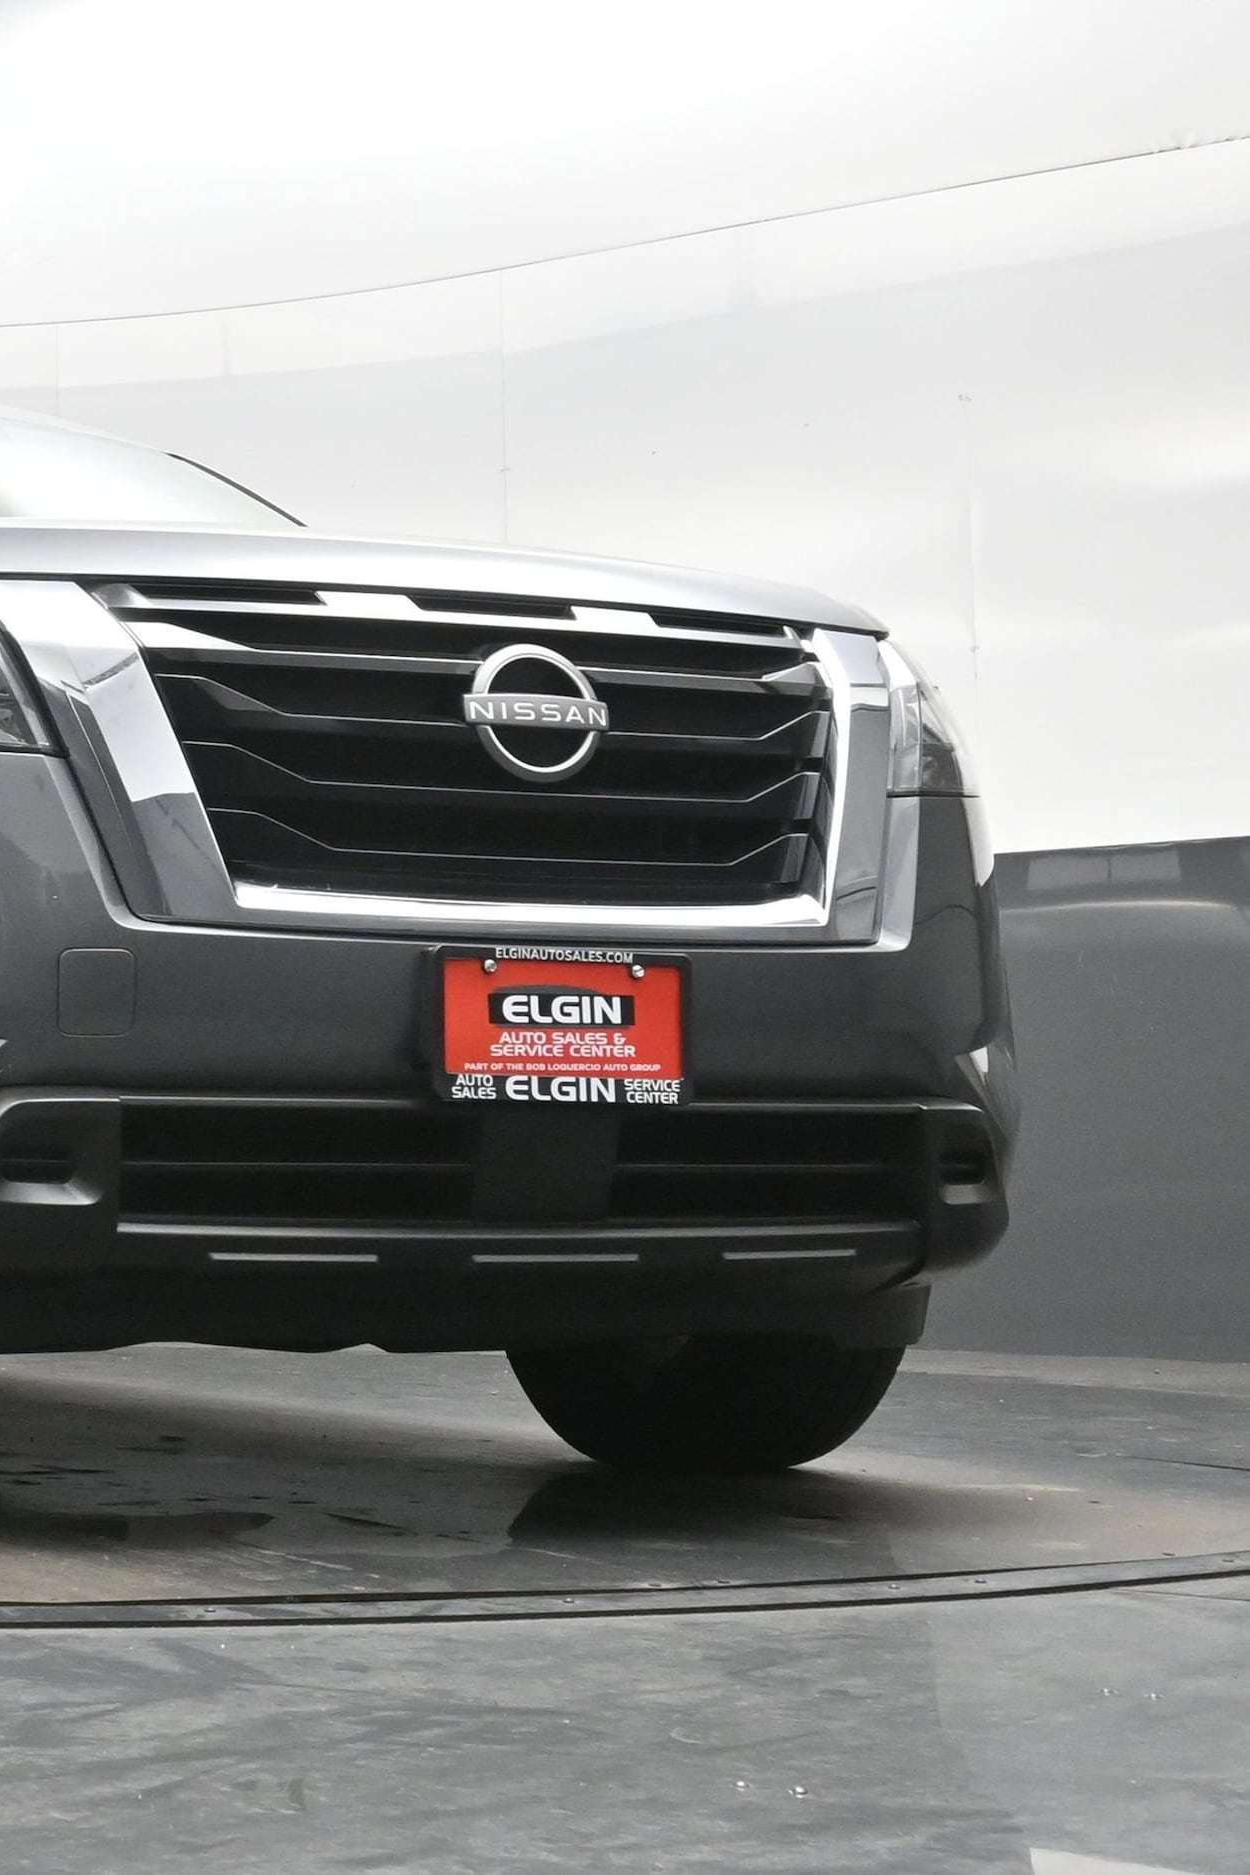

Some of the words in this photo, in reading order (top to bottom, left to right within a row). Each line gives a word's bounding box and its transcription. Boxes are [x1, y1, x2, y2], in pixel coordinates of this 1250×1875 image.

[469, 701, 607, 726] NISSAN
[494, 947, 633, 964] ELGINAUTOSALES.COM
[502, 995, 622, 1024] ELGIN
[499, 1031, 547, 1045] AUTO
[551, 1032, 607, 1045] SALES
[613, 1033, 626, 1045] &
[490, 1044, 564, 1057] SERVICE
[570, 1045, 636, 1058] CENTER
[464, 1062, 488, 1071] PART
[490, 1062, 504, 1071] OF
[506, 1062, 524, 1071] THE
[526, 1063, 546, 1071] BOB
[547, 1063, 601, 1071] LOQUERCIO
[603, 1063, 628, 1072] AUTO
[630, 1064, 661, 1072] GROUP
[456, 1074, 494, 1086] AUTO
[623, 1078, 681, 1092] SERVICE
[451, 1086, 497, 1099] SALES
[505, 1075, 616, 1103] ELGIN
[626, 1091, 679, 1104] CENTER
